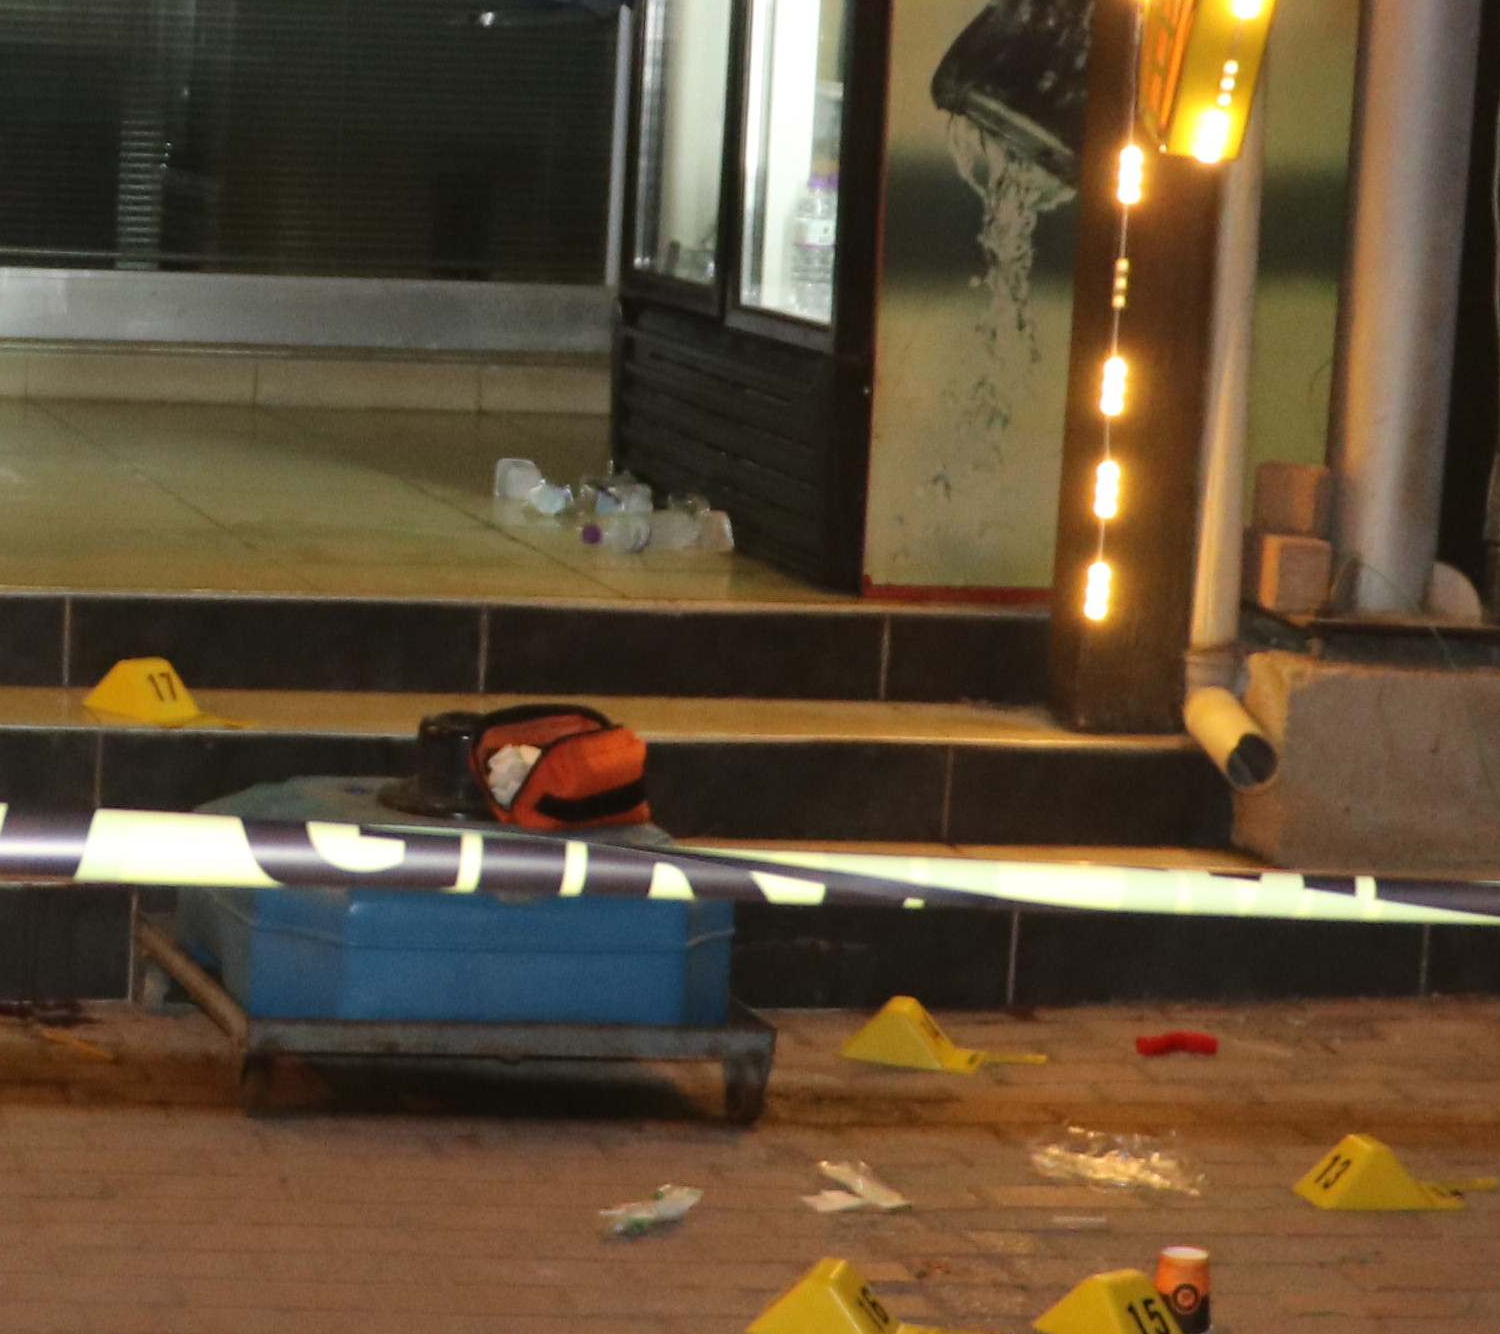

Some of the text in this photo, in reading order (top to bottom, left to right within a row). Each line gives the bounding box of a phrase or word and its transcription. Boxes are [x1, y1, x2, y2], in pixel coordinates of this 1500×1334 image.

[147, 671, 178, 702] 17
[1313, 1153, 1354, 1190] 13
[855, 1284, 891, 1333] 16
